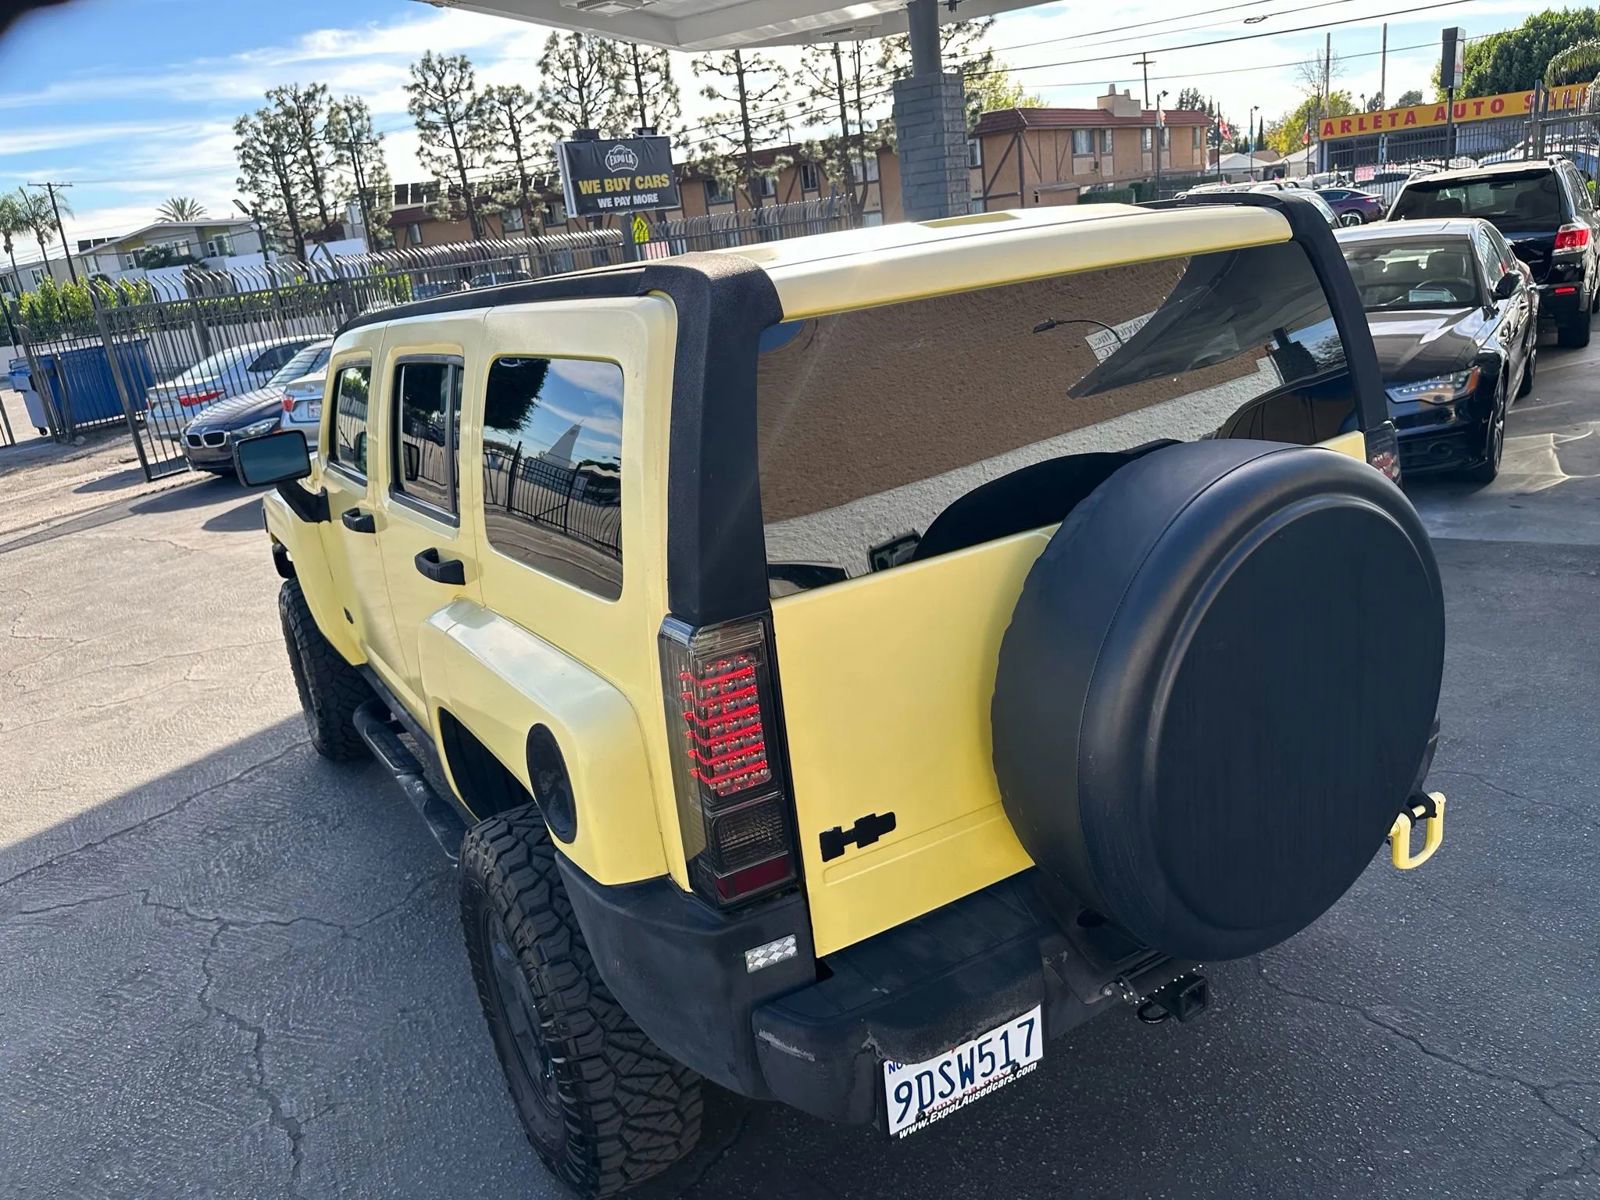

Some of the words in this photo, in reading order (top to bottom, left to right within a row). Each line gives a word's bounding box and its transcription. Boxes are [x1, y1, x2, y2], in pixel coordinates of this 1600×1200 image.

[1323, 111, 1417, 136] ARLETA
[1434, 98, 1505, 122] AUTO
[578, 179, 602, 195] WE
[604, 177, 631, 192] BUY
[635, 173, 670, 190] CARS
[597, 197, 613, 208] WE
[614, 196, 631, 207] PAY
[633, 193, 659, 205] MORE
[893, 1017, 1035, 1124] 9DSW517
[899, 1061, 1038, 1139] www.ExpoLAusedcars.com
